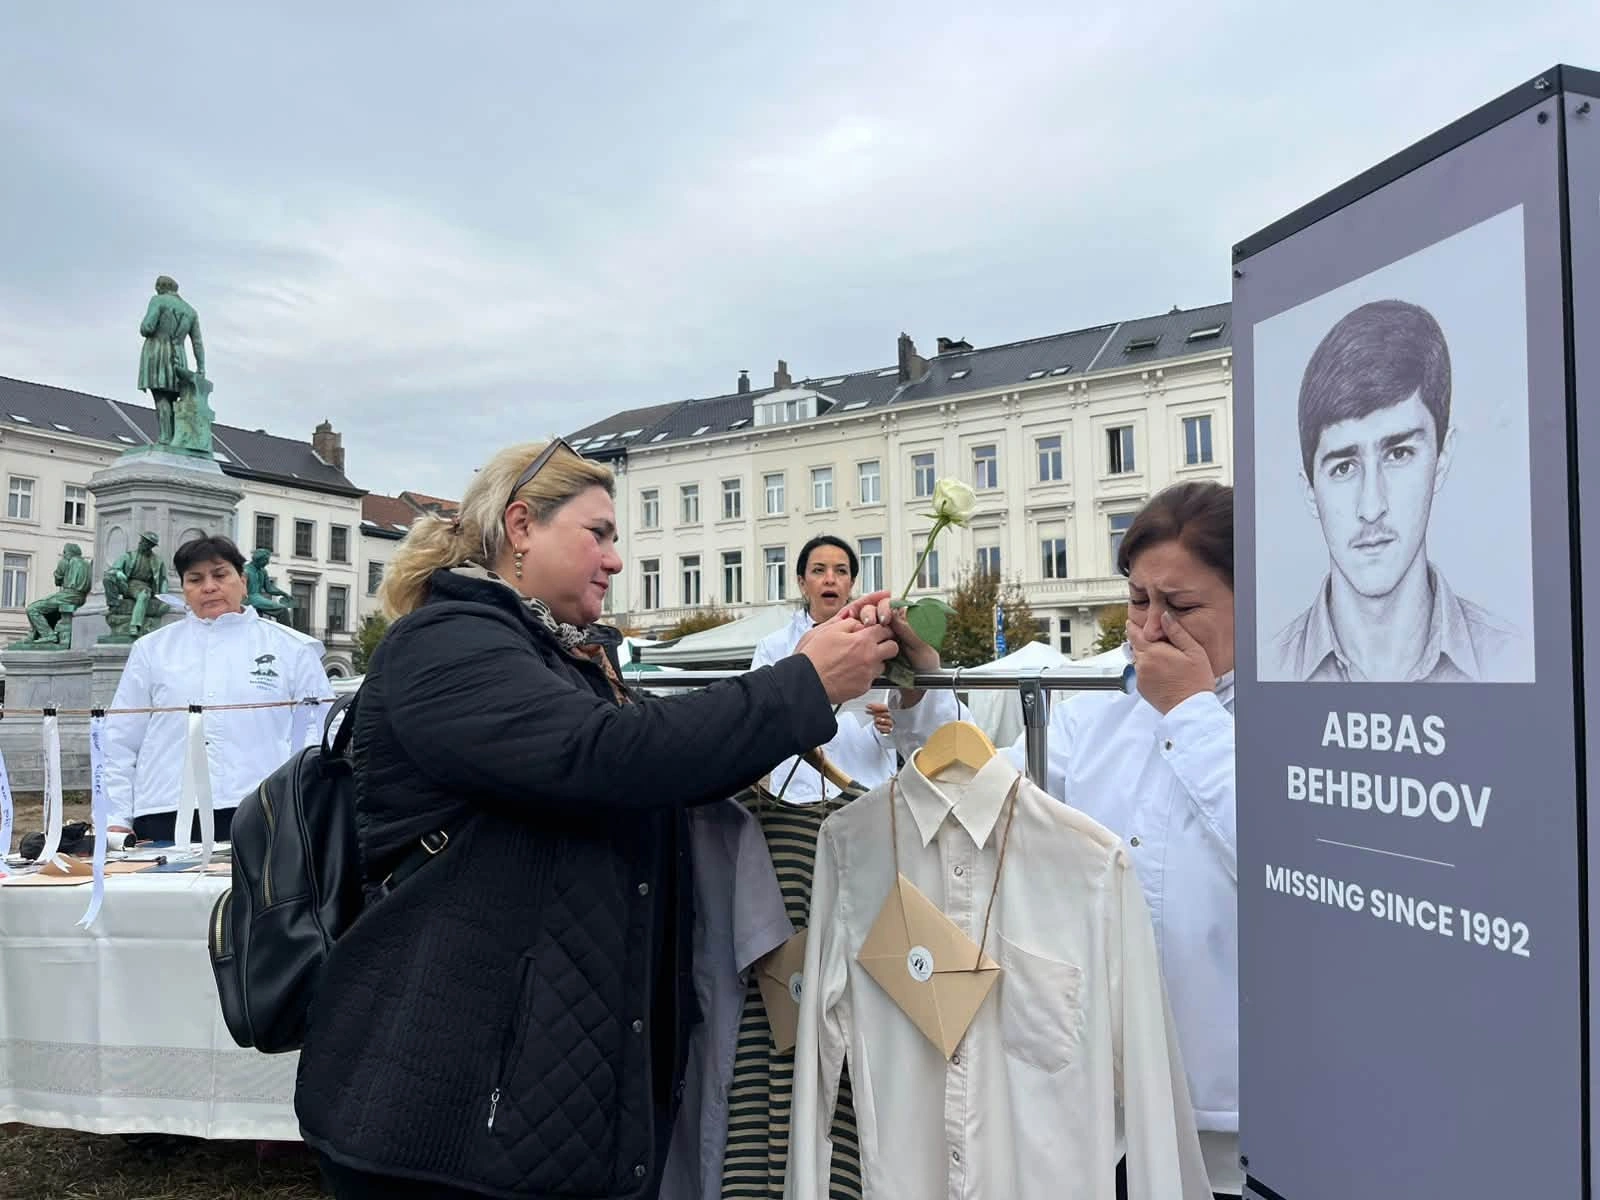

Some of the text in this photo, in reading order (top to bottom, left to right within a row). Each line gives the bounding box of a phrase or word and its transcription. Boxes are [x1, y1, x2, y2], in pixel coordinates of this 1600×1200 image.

[1321, 711, 1446, 756] ABBAS
[1287, 765, 1492, 829] BEHBUDOV
[1265, 863, 1531, 958] MISSING SINCE 1992
